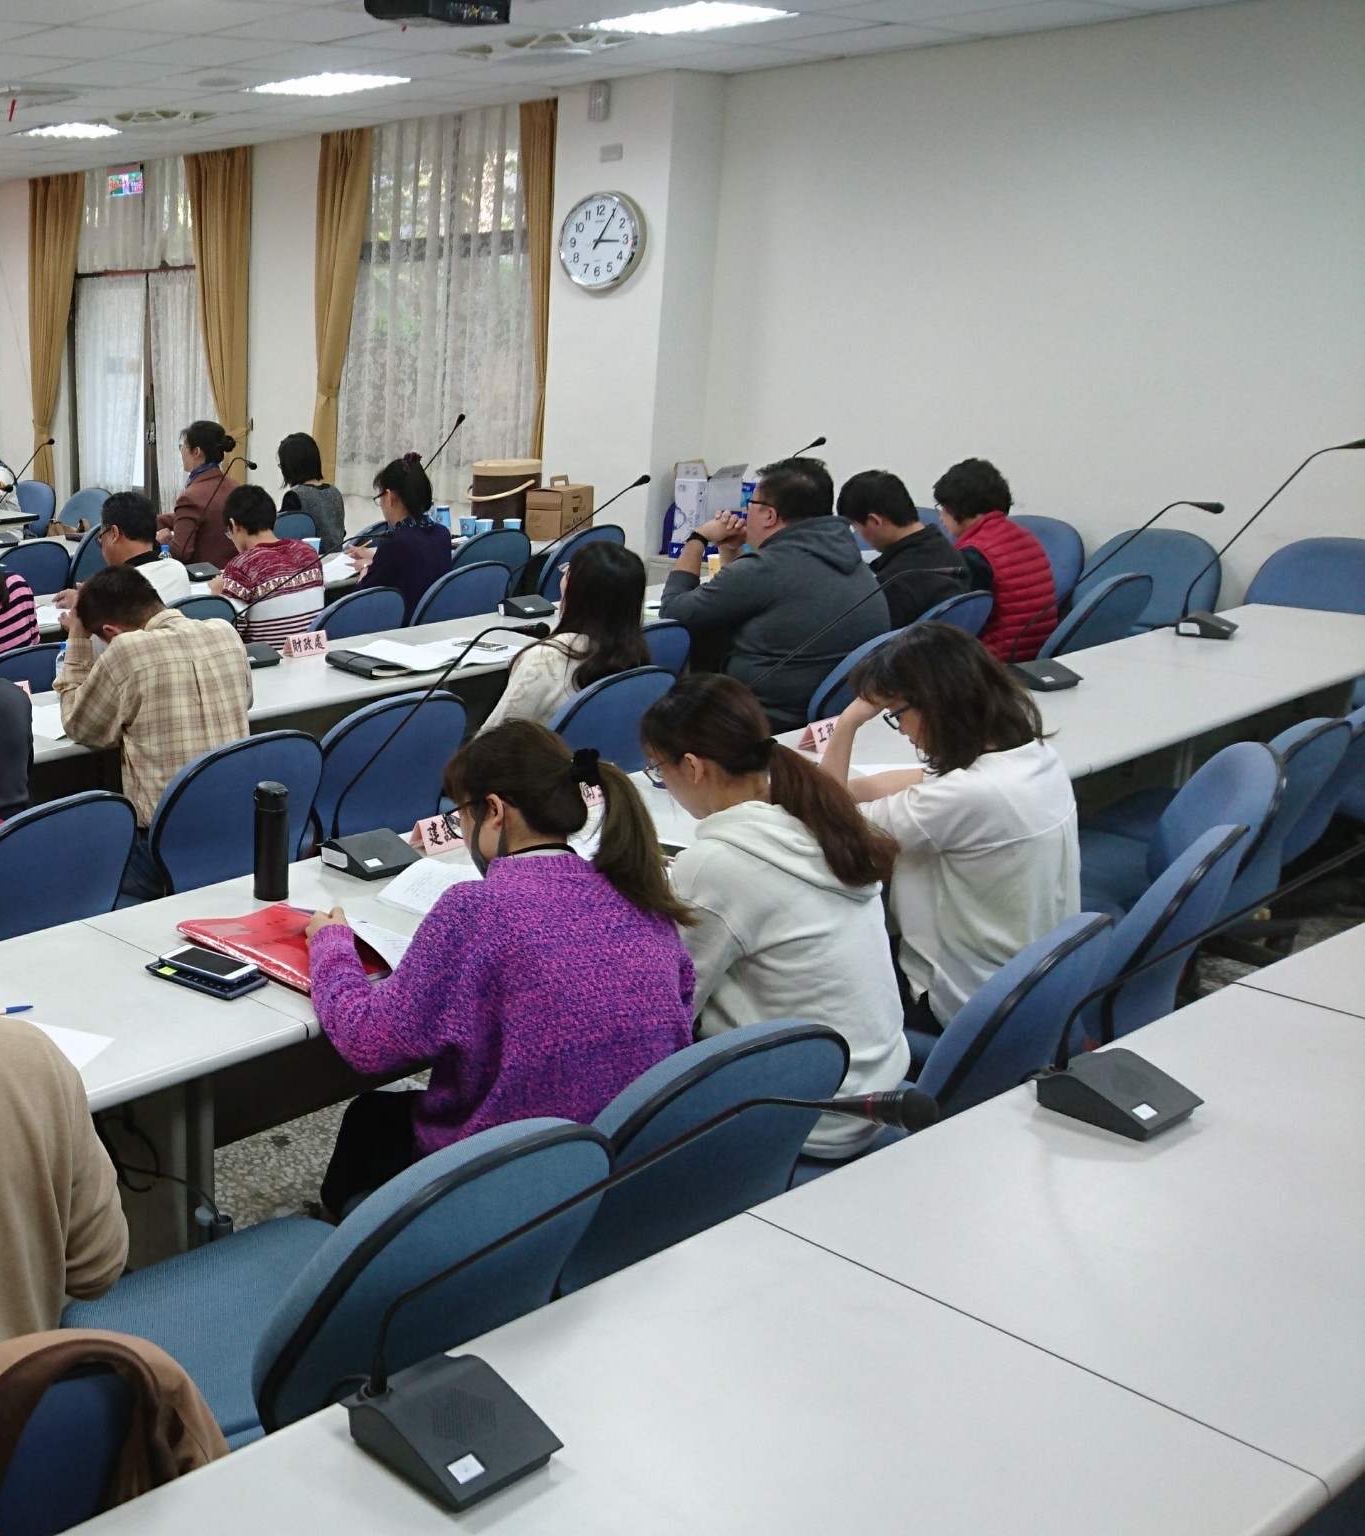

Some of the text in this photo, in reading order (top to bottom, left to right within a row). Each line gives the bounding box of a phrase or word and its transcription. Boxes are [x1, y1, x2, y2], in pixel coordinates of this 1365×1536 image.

[585, 210, 591, 221] 11
[596, 204, 606, 216] 12
[575, 222, 584, 233] 10
[619, 217, 626, 229] 2
[569, 237, 577, 248] 9
[622, 233, 629, 245] 3
[572, 252, 580, 263] 8
[616, 250, 623, 261] 4
[583, 263, 590, 274] 7
[593, 266, 601, 277] 6
[606, 262, 613, 273] 5
[292, 633, 326, 654] 財政處
